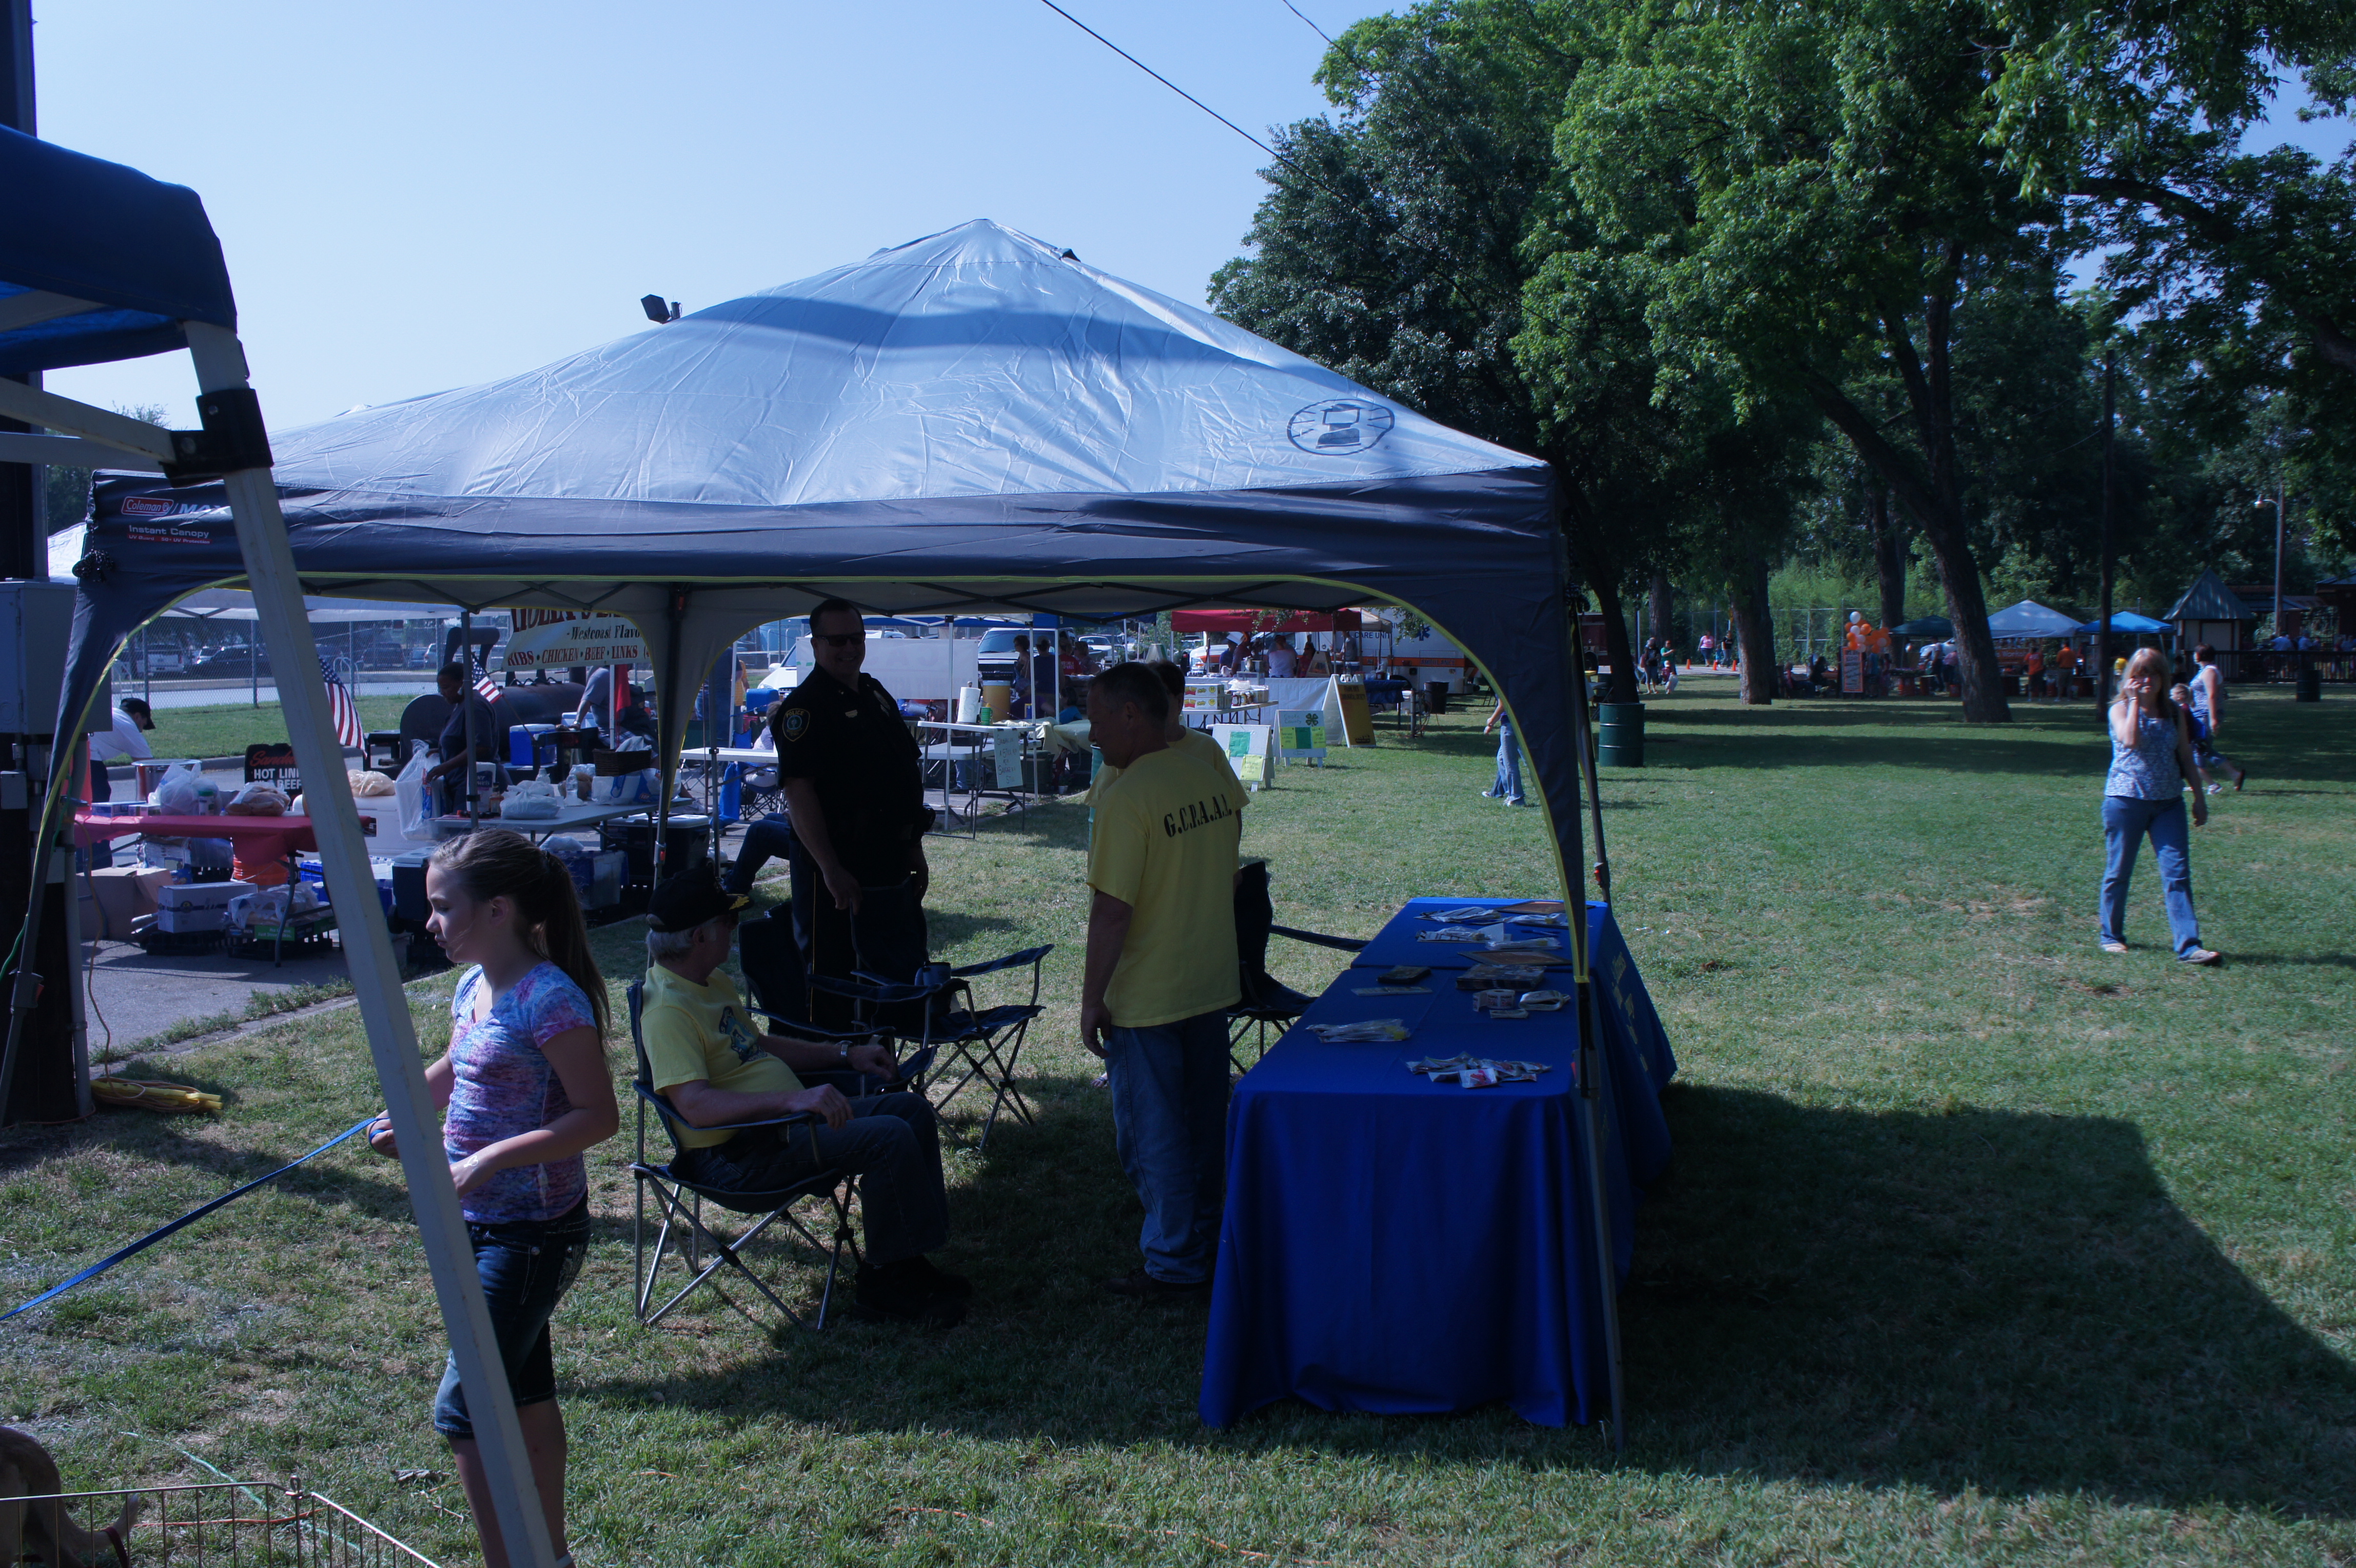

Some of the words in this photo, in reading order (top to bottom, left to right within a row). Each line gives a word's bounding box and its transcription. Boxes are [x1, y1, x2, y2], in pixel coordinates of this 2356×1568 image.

[127, 499, 161, 512] Coleman
[129, 525, 167, 535] Instant
[170, 528, 209, 538] Canopy
[614, 624, 642, 639] Flavo
[507, 651, 535, 666] RIBS
[542, 648, 579, 664] CHICKEN
[584, 646, 605, 661] BEEF
[612, 645, 638, 659] LINKS
[254, 769, 276, 779] HOT
